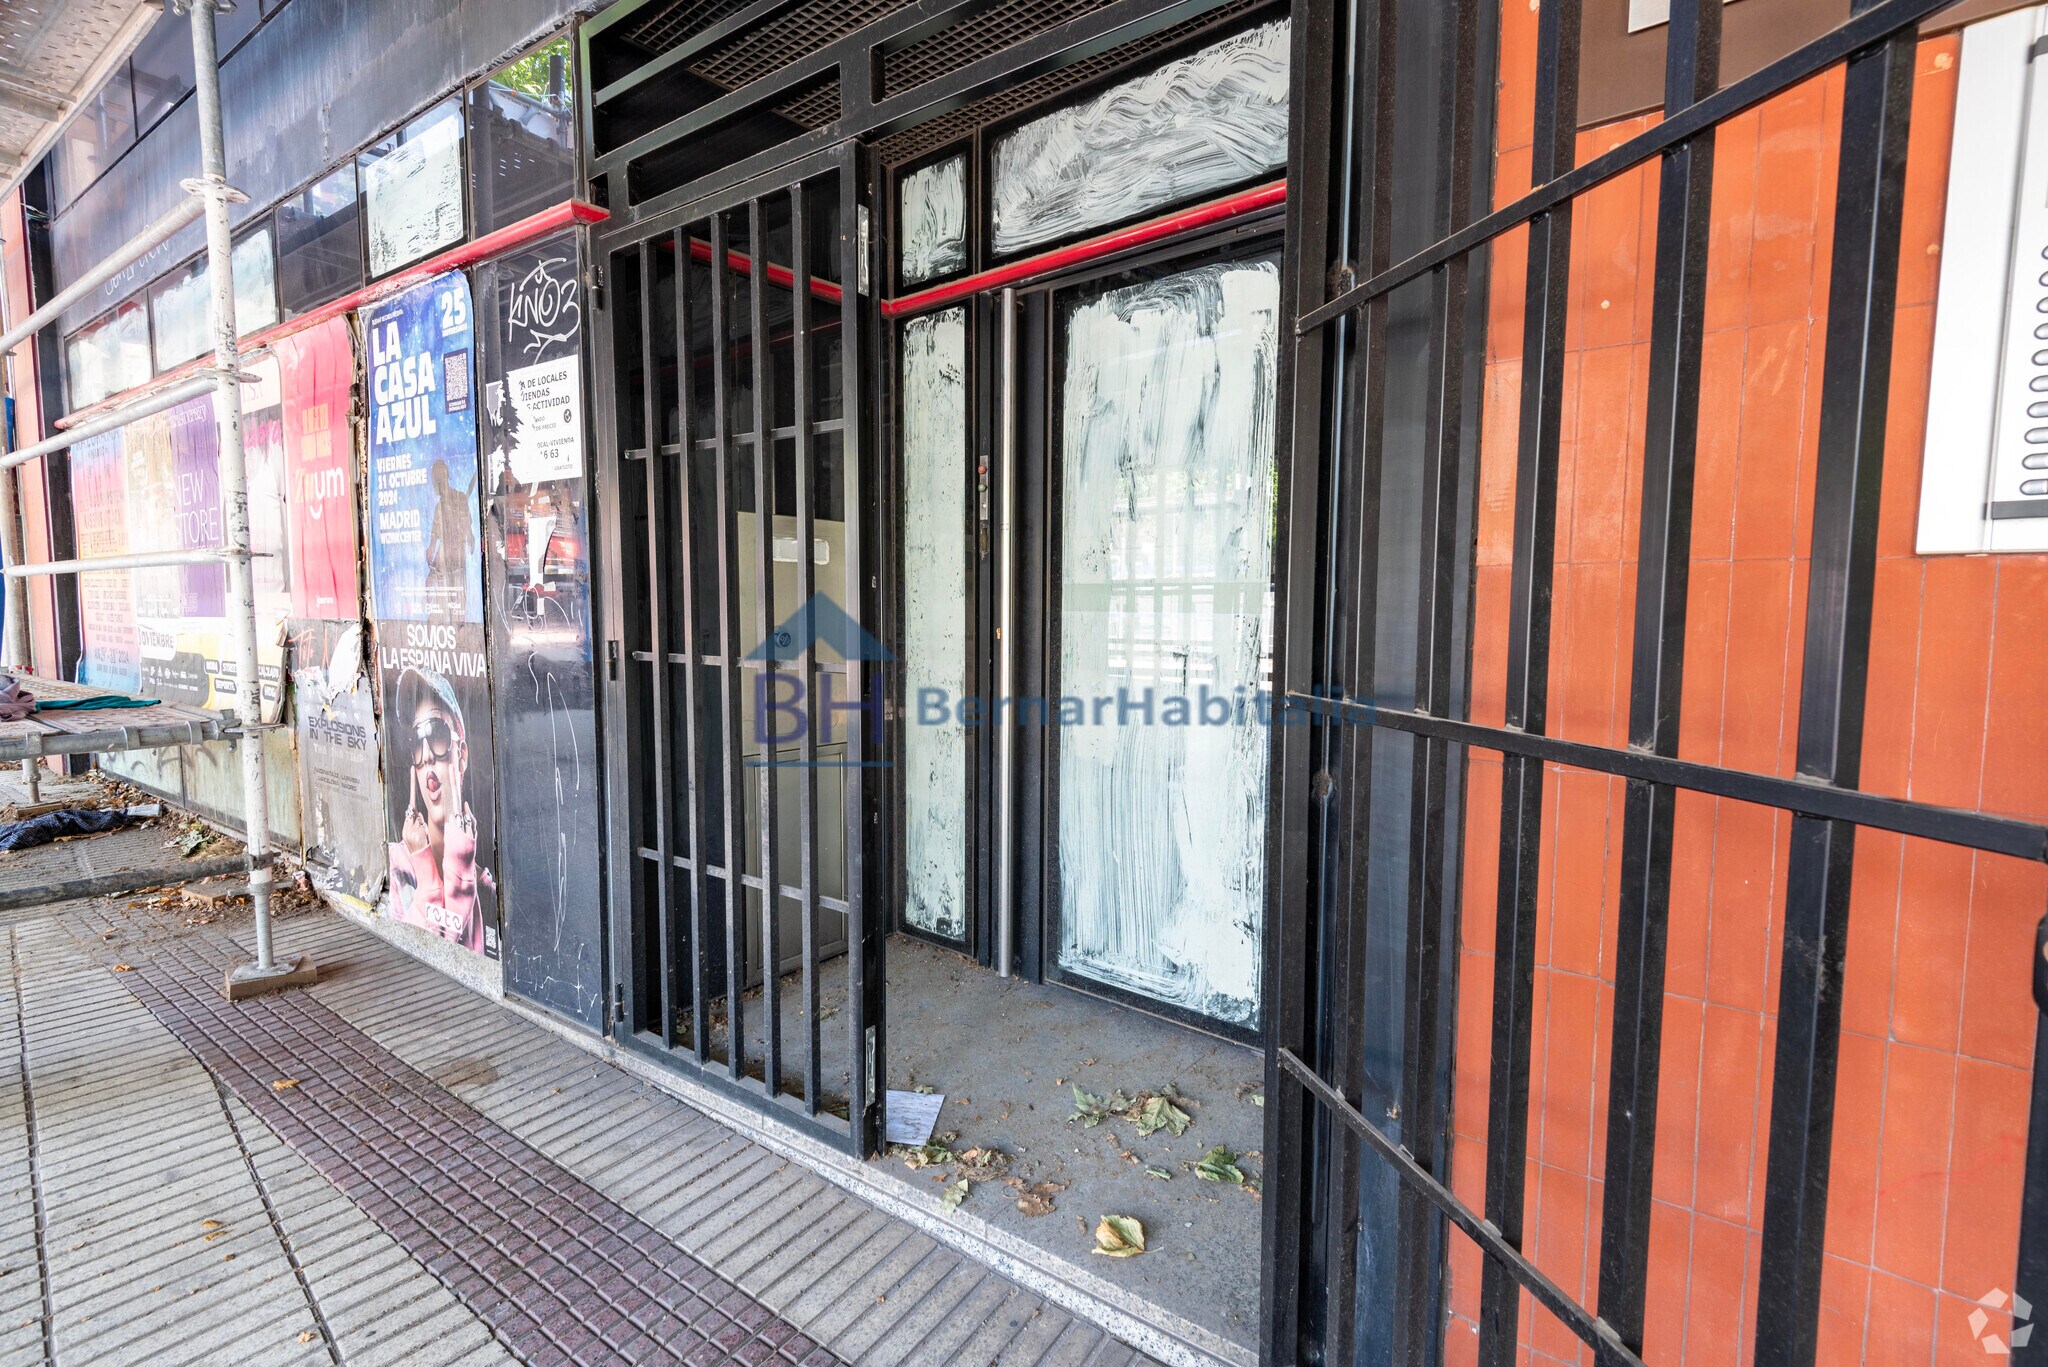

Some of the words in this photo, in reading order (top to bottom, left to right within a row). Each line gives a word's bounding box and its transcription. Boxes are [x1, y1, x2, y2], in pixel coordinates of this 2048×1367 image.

[441, 286, 467, 330] 25
[372, 320, 402, 367] LA
[374, 351, 436, 406] CASA
[527, 378, 537, 389] DE
[537, 370, 568, 386] LOCALES
[532, 395, 570, 411] ACTIVIDAD
[375, 394, 437, 445] AZUL
[376, 453, 412, 474] VIERNES
[173, 469, 205, 508] NEW
[388, 468, 428, 489] OCTUBRE
[378, 489, 398, 507] 2024
[175, 507, 220, 546] STORE
[380, 509, 420, 530] MADRID
[407, 623, 457, 650] SOMOS
[382, 646, 400, 670] LA
[400, 645, 452, 675] ESPAÑA
[452, 651, 487, 678] VIVA
[308, 715, 367, 739] EXPLOSIONS
[309, 728, 319, 741] IN
[324, 731, 342, 746] THE
[347, 736, 367, 751] SKY
